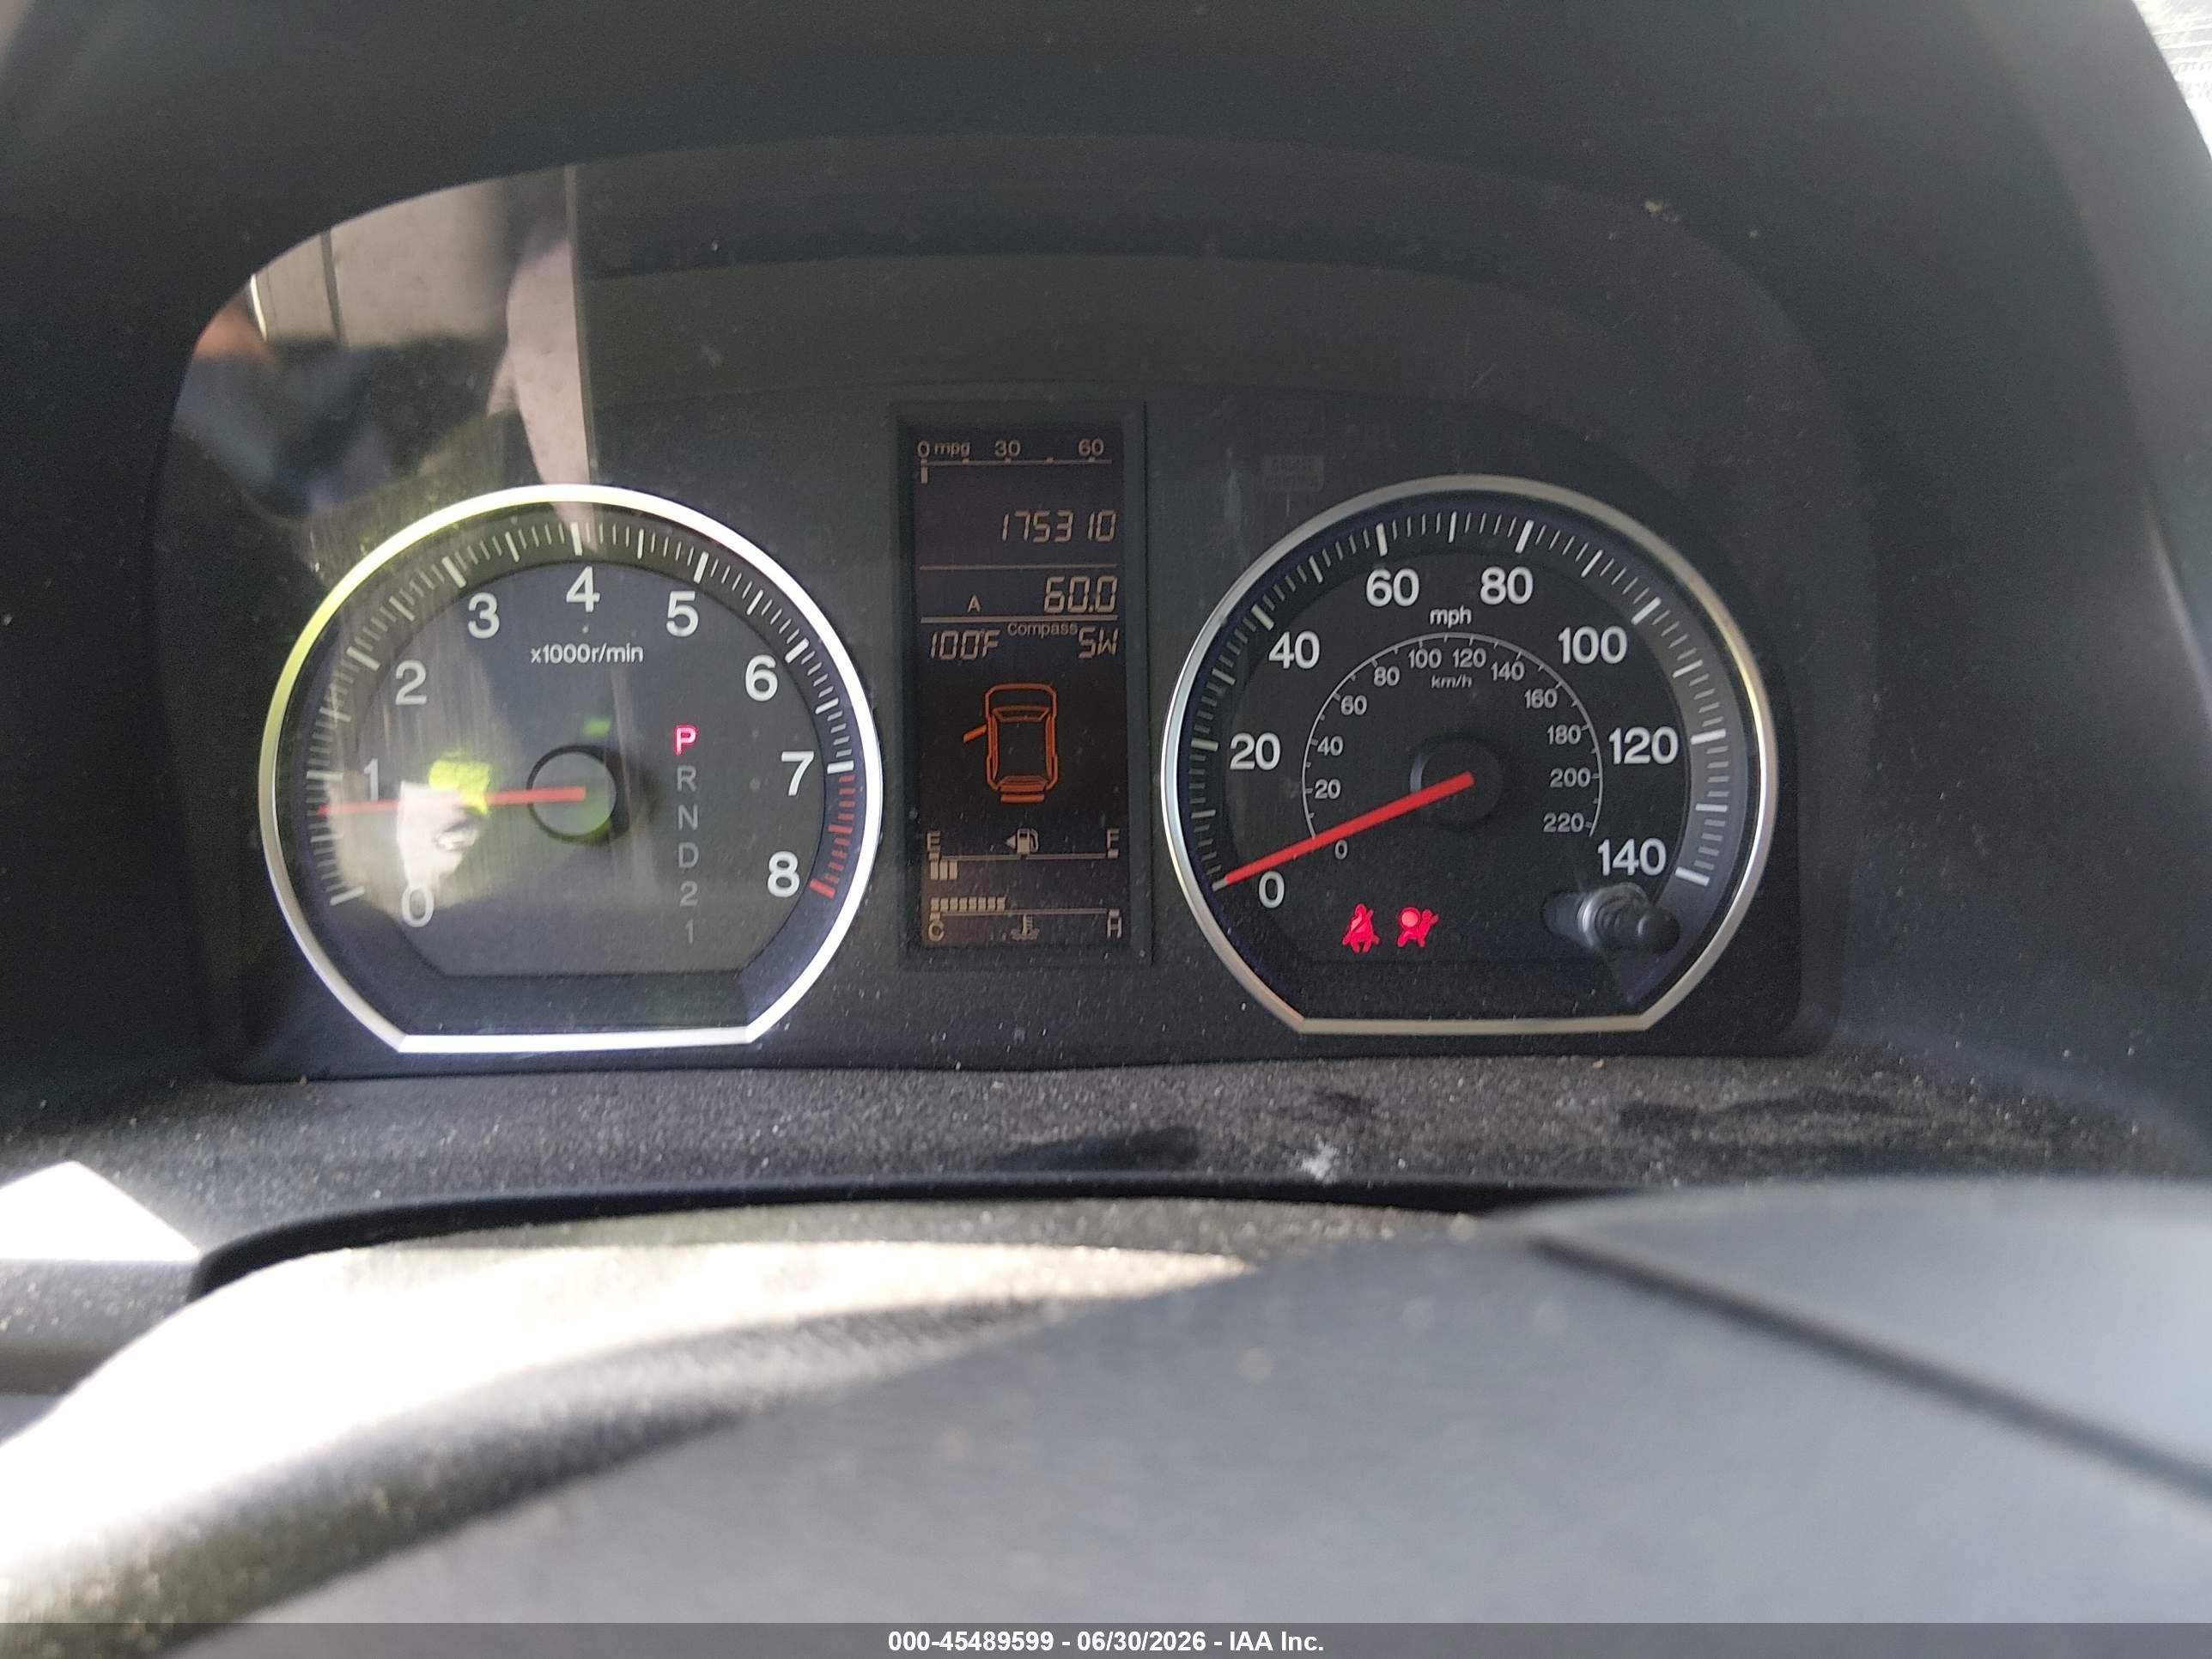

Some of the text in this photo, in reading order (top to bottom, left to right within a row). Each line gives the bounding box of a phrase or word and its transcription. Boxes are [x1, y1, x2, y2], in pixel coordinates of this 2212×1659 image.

[918, 440, 1103, 457] 0 mpg 30 60
[1001, 510, 1116, 543] 175310
[567, 567, 600, 611] 4
[967, 576, 1117, 613] A 60.0
[1366, 568, 1419, 605] 60
[1480, 567, 1533, 605] 80
[468, 593, 500, 638] 3
[666, 591, 698, 637] 5
[1430, 608, 1471, 626] mph
[531, 644, 643, 665] x1000r/min
[1079, 627, 1118, 659] SW
[1269, 631, 1320, 669] 40
[1559, 627, 1627, 663] 100
[1408, 649, 1442, 668] 100
[1453, 649, 1486, 668] 120
[395, 661, 427, 705] 2
[745, 655, 778, 700] 6
[1375, 667, 1400, 686] 80
[1431, 673, 1472, 689] km/h
[1492, 661, 1525, 681] 140
[1341, 696, 1367, 715] 60
[1525, 690, 1557, 709] 160
[676, 726, 697, 755] P
[1317, 737, 1343, 756] 40
[1547, 726, 1581, 744] 180
[1609, 726, 1678, 764] 120
[1230, 733, 1280, 769] 20
[364, 760, 378, 800] 1
[678, 768, 697, 792] R
[781, 751, 814, 795] 7
[1550, 769, 1590, 787] 200
[1315, 780, 1340, 799] 20
[678, 806, 698, 830] N
[1543, 813, 1584, 832] 220
[927, 829, 1120, 852] E F
[1334, 842, 1346, 860] 0
[678, 843, 698, 867] D
[1598, 839, 1666, 875] 140
[768, 851, 799, 896] 8
[679, 882, 698, 906] 2
[1258, 872, 1285, 908] 0
[401, 881, 434, 927] 0
[684, 921, 694, 944] 1
[927, 921, 944, 941] C
